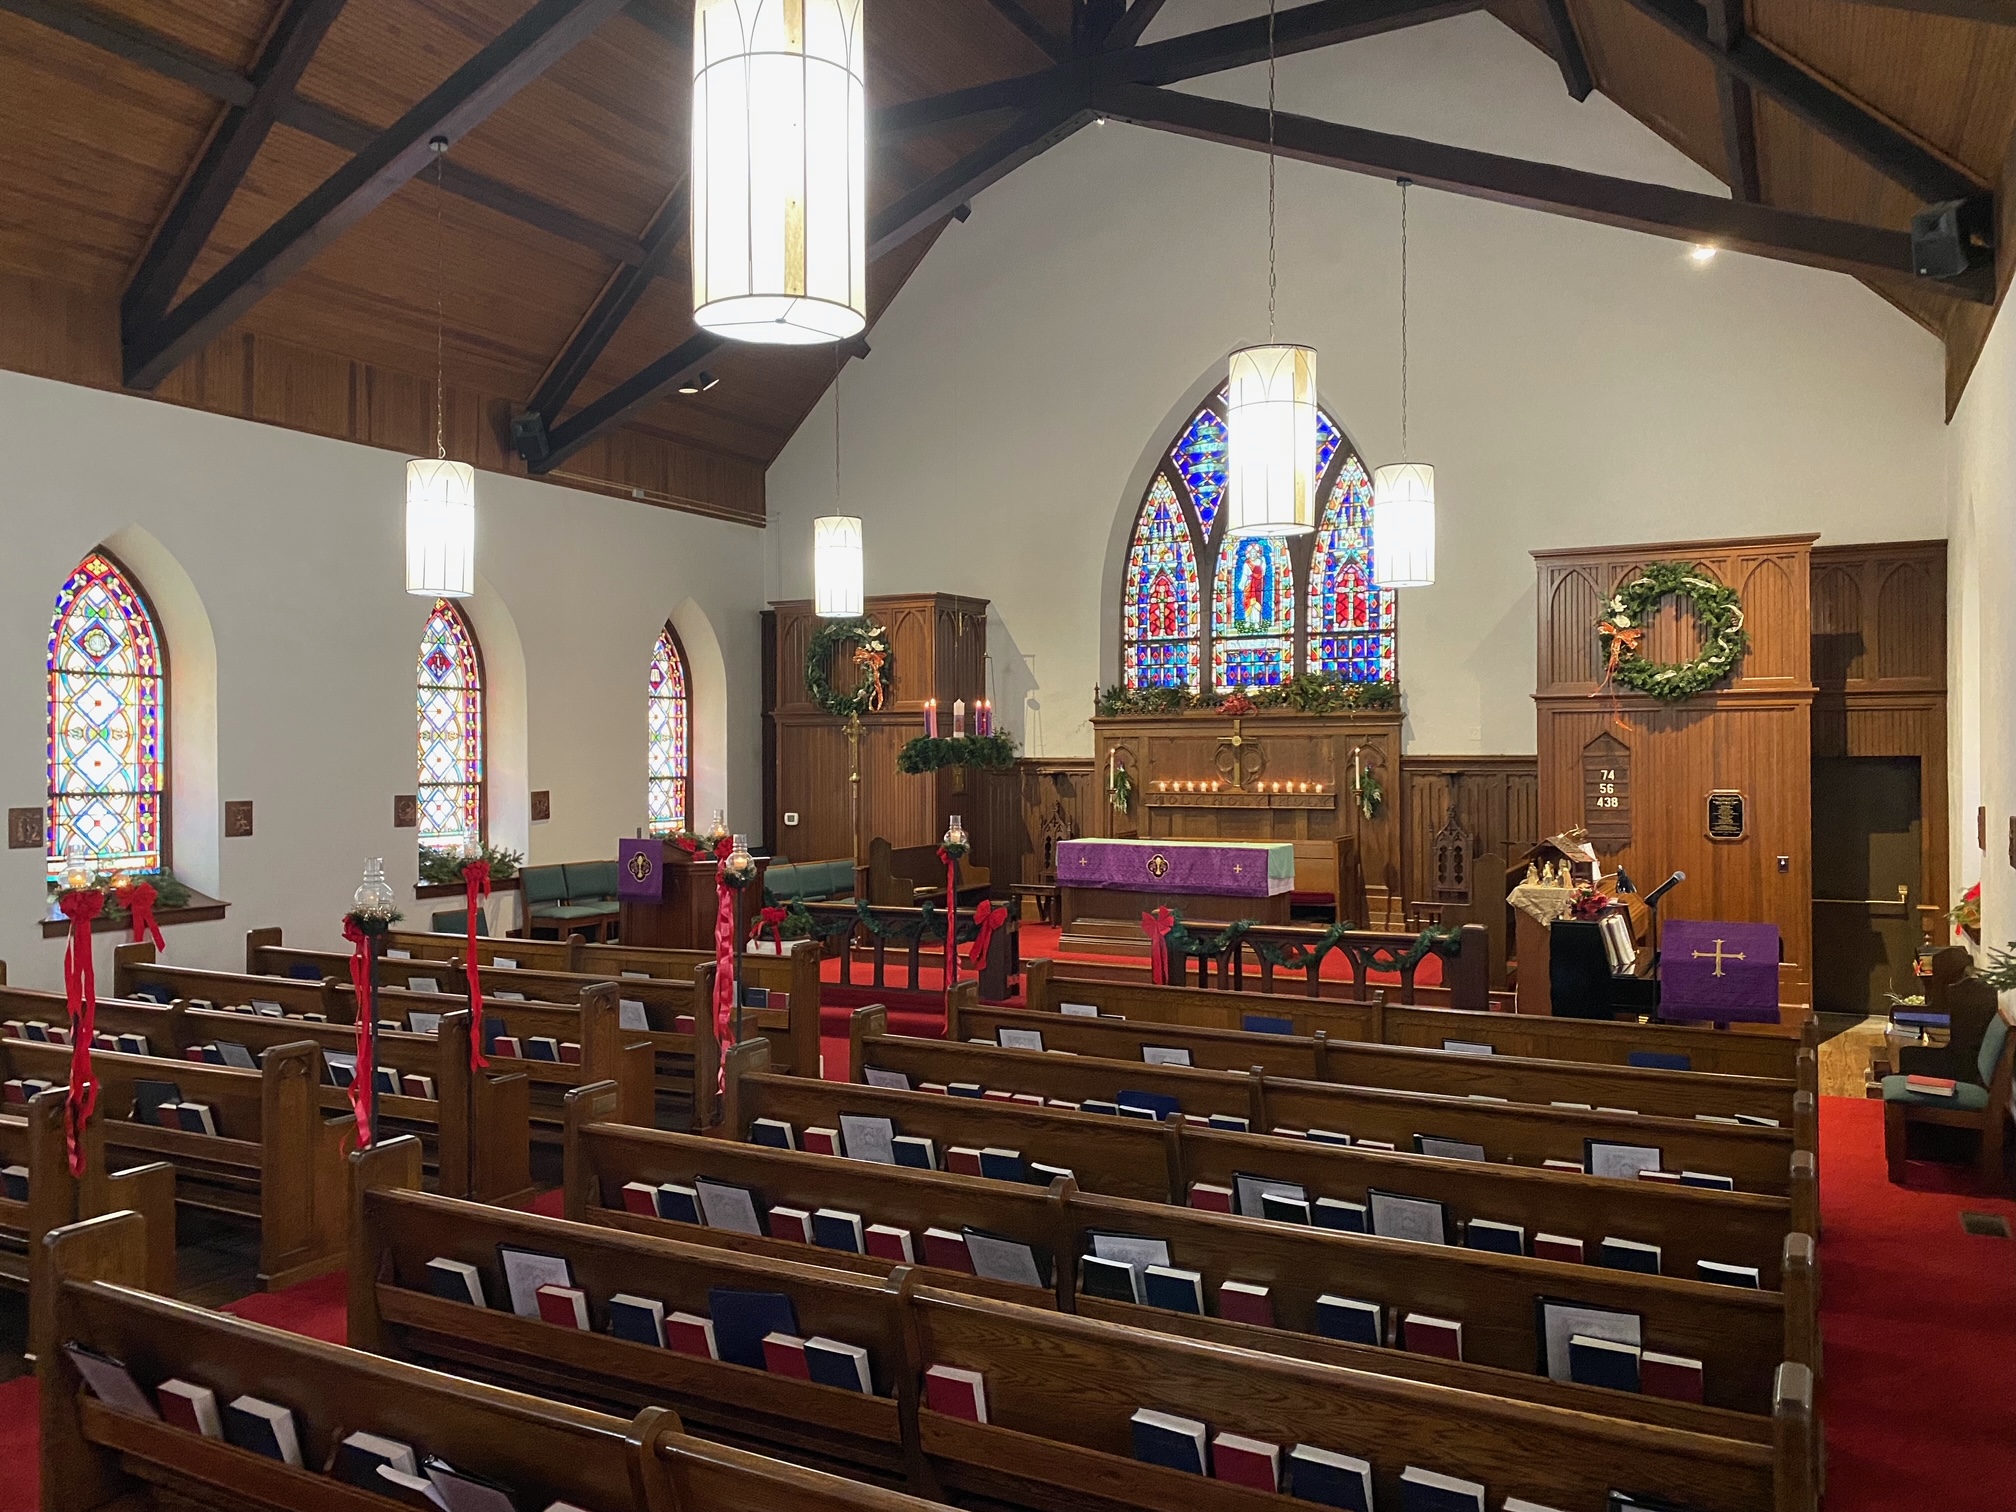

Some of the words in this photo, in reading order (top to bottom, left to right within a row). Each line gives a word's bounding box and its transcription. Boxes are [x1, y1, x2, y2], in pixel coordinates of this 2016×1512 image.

[1600, 769, 1615, 780] 74
[1599, 783, 1614, 794] 56
[1596, 796, 1619, 808] 438
